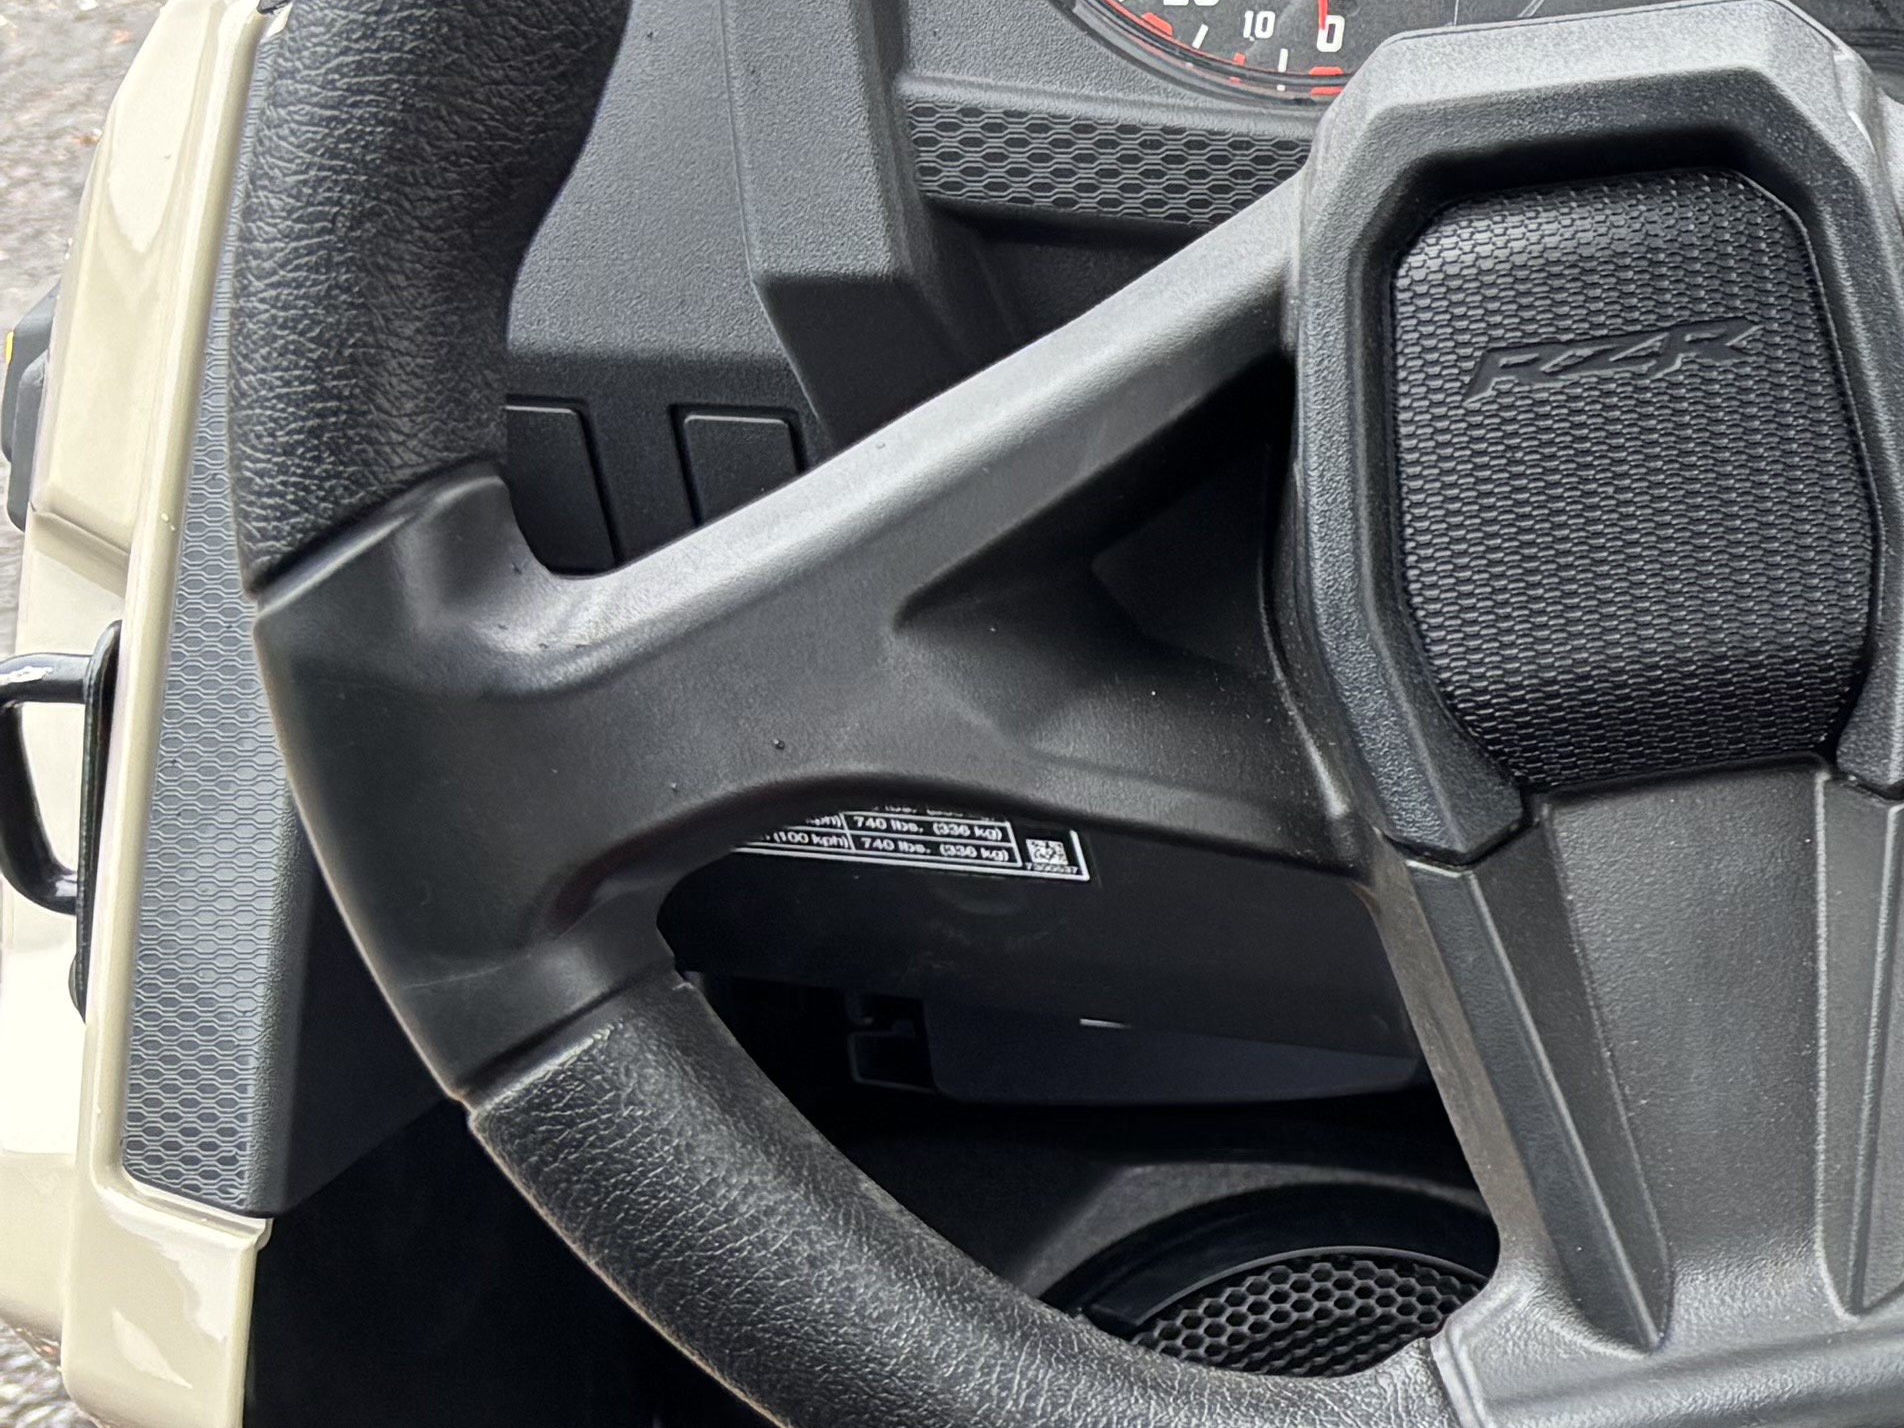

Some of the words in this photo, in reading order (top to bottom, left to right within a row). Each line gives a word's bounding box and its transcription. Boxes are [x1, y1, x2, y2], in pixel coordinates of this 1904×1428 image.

[1242, 10, 1275, 39] 10
[1316, 16, 1345, 52] 0
[853, 816, 888, 830] 740
[974, 825, 1003, 841] kg)
[773, 831, 809, 843] (100
[811, 833, 849, 849] kph)
[861, 837, 895, 851] 740
[980, 847, 1009, 862] kg)
